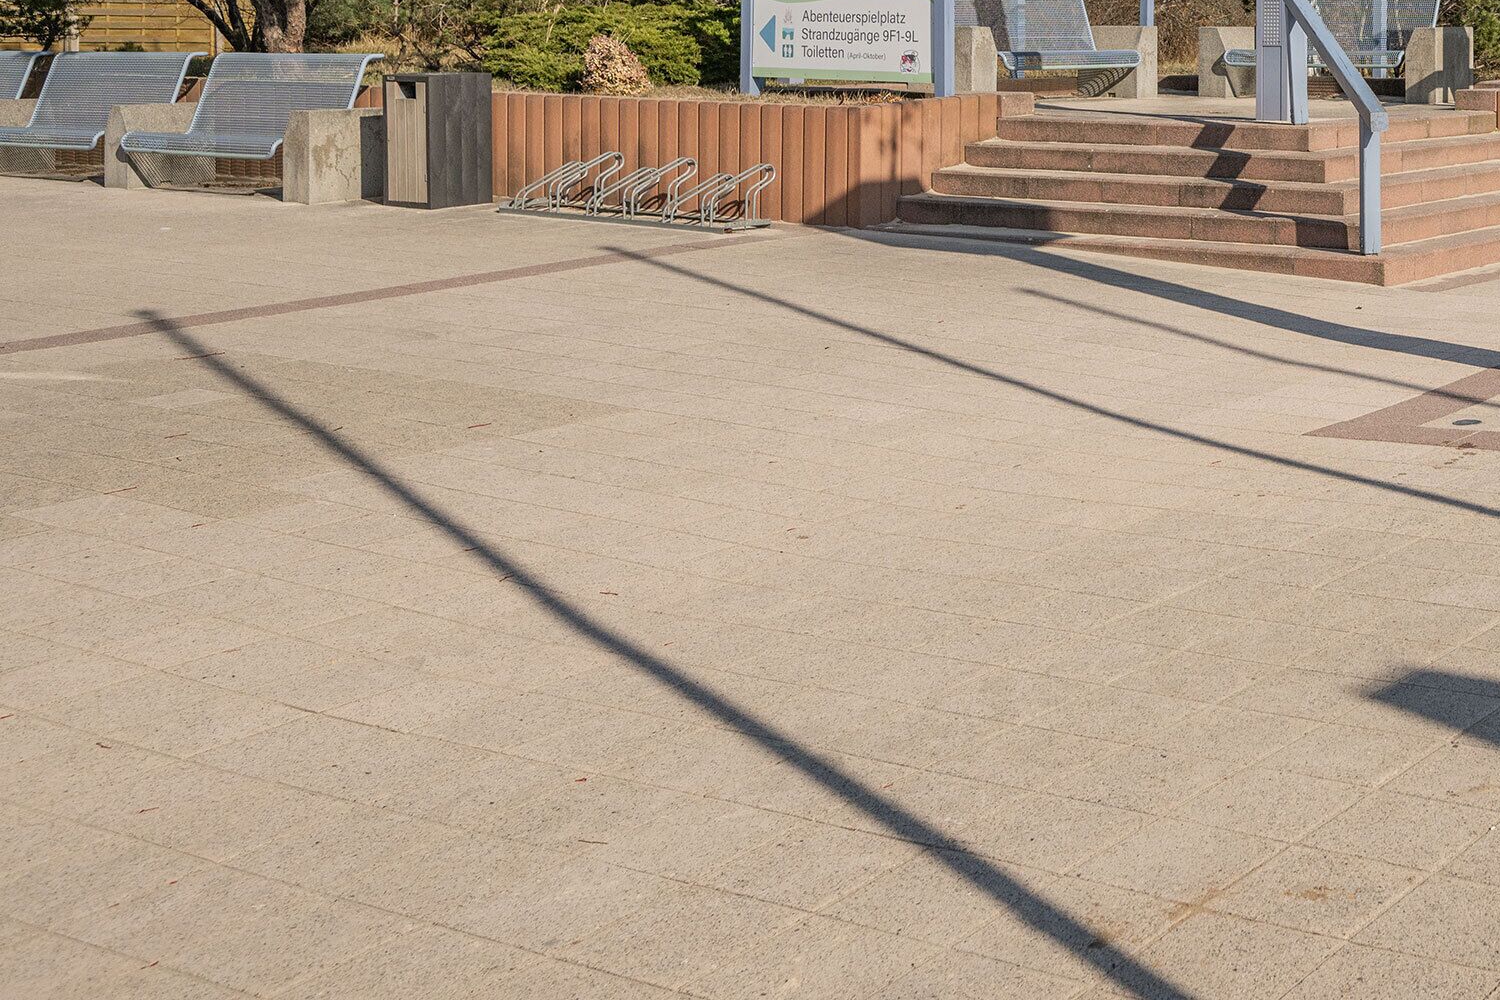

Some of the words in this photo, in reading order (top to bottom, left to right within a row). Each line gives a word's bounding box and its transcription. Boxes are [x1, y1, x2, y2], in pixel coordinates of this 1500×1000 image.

[802, 10, 906, 28] Abenteuerspielplatz
[801, 28, 880, 45] Strandzugänge
[882, 30, 919, 43] 9F1-9L
[801, 45, 845, 59] Toiletten
[847, 51, 887, 61] (April-Oktober)
